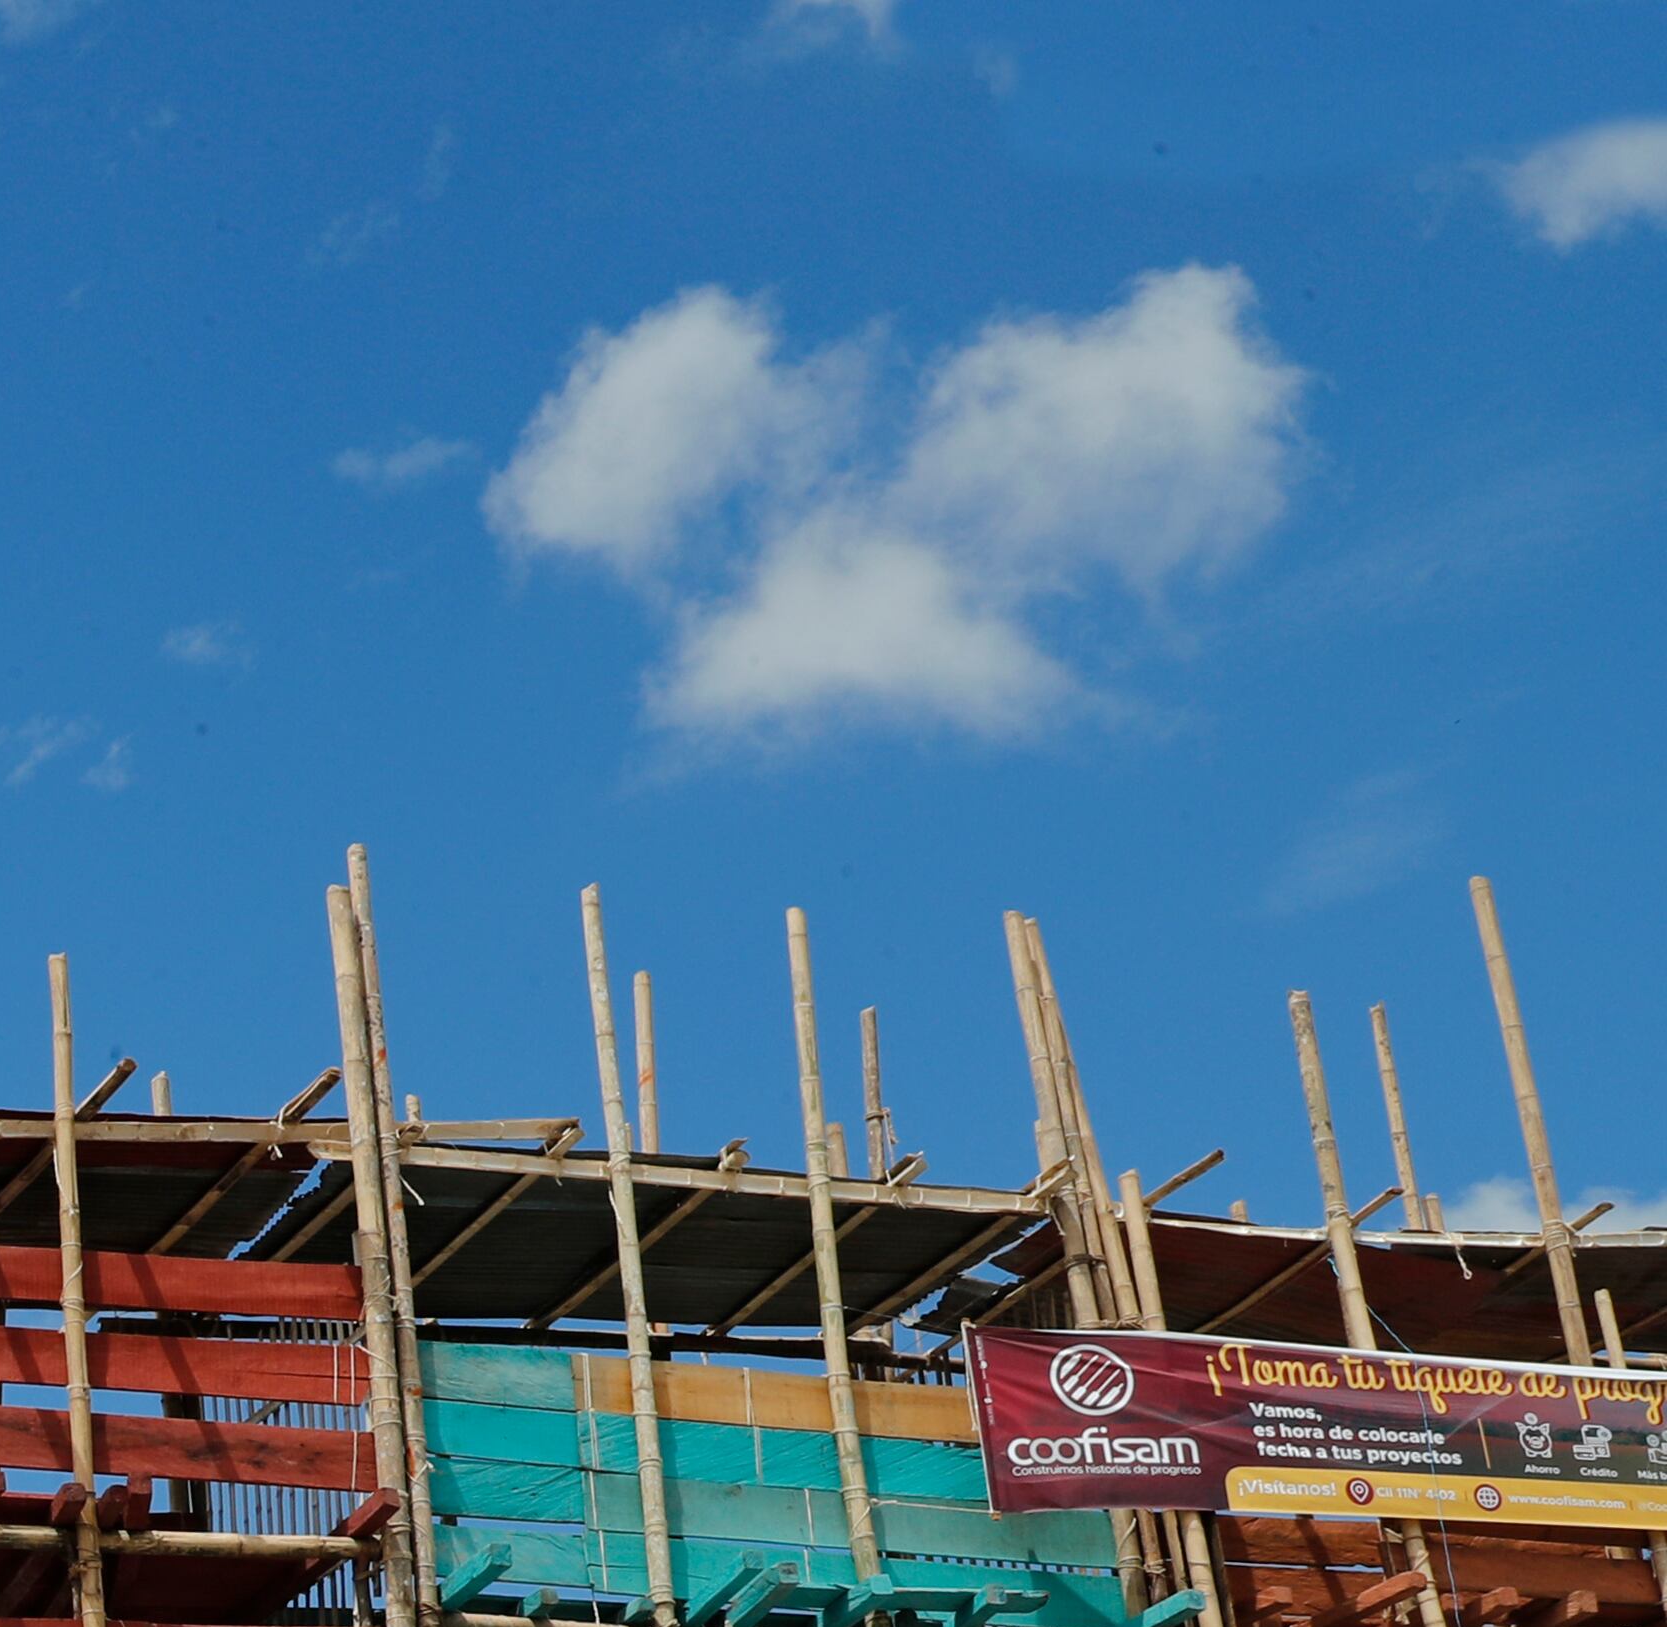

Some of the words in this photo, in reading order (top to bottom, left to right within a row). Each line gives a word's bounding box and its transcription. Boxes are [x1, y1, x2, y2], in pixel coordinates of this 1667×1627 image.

[1205, 1343, 1339, 1397] ¡Toma
[1337, 1354, 1386, 1390] tu
[1384, 1358, 1514, 1415] tiquete
[1519, 1371, 1567, 1398] de
[1249, 1402, 1322, 1422] Vamos,
[1253, 1425, 1275, 1437] es
[1280, 1423, 1324, 1439] hora
[1329, 1425, 1354, 1440] de
[1358, 1427, 1445, 1444] colocarle
[1007, 1426, 1200, 1466] coofisam
[1257, 1442, 1311, 1458] fecha
[1316, 1447, 1328, 1458] a
[1332, 1445, 1363, 1460] tus
[1367, 1448, 1463, 1466] proyectos
[1012, 1466, 1084, 1477] Construimos
[1085, 1464, 1132, 1475] historias
[1133, 1465, 1149, 1475] de
[1150, 1466, 1202, 1477] progreso
[1524, 1464, 1561, 1475] Ahorro
[1579, 1466, 1618, 1478] Crédito
[1637, 1469, 1659, 1480] Más
[1238, 1479, 1337, 1497] ¡Visítanos!
[1508, 1493, 1626, 1510] www.coofisam.com
